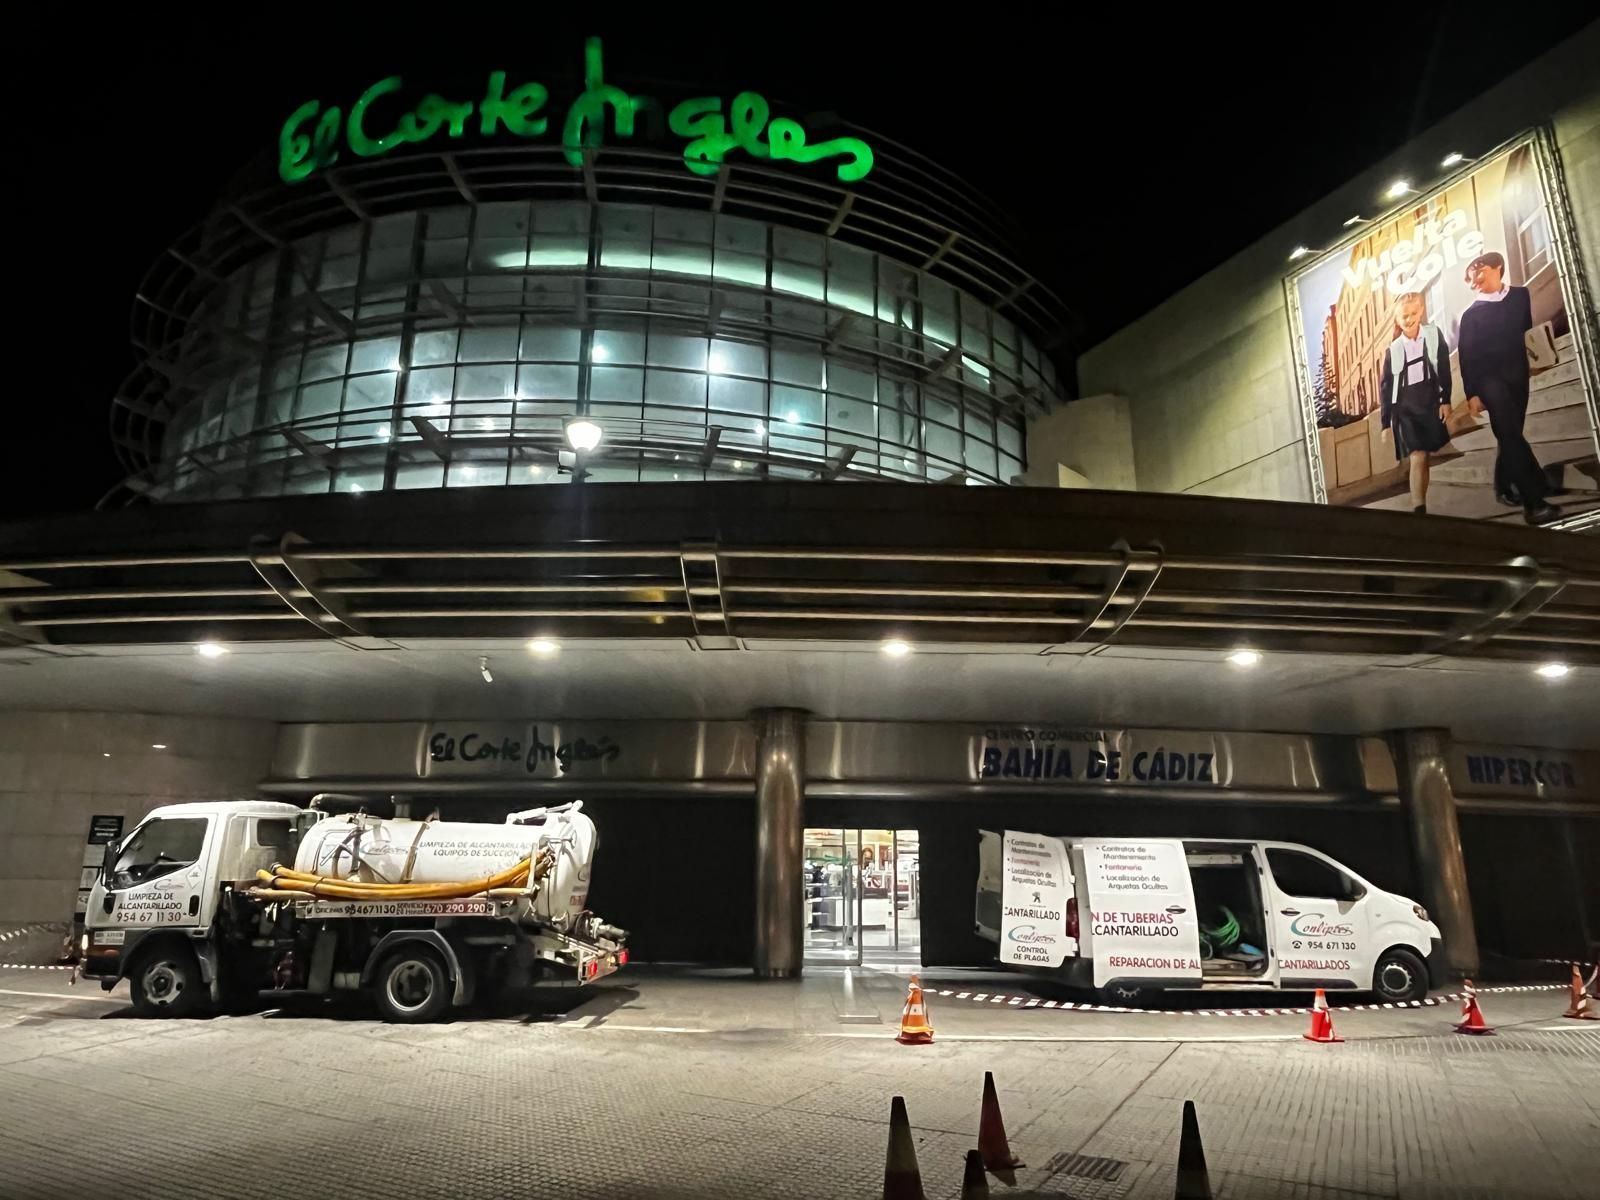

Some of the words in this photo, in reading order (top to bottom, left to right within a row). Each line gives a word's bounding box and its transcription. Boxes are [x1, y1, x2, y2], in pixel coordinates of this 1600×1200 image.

[279, 99, 341, 182] El
[347, 70, 549, 157] Corte
[1341, 209, 1467, 288] Vuelta
[1386, 230, 1485, 295] Cole
[430, 733, 455, 762] El
[460, 733, 521, 762] Corte
[984, 744, 1072, 778] BAHÍA
[1087, 751, 1121, 780] DE
[1132, 747, 1214, 782] CÁDIZ
[419, 841, 456, 849] LIMPIEZA
[1101, 845, 1135, 853] Contratos
[433, 849, 469, 857] EQUIPOS
[470, 849, 481, 857] DE
[1108, 882, 1140, 891] Arquetas
[1141, 882, 1168, 890] Ocultas
[128, 892, 162, 901] LIMPIEZA
[163, 892, 174, 901] DE
[118, 902, 182, 910] ALCANTARILLADO
[424, 903, 444, 914] 670
[445, 903, 465, 914] 290
[467, 903, 486, 914] 290
[117, 912, 136, 923] 954
[140, 912, 153, 922] 67
[156, 911, 164, 922] 11
[168, 912, 182, 922] 30
[1103, 912, 1118, 922] DE
[1120, 912, 1174, 924] TUBERIAS
[1016, 945, 1048, 955] CONTROL
[1307, 941, 1324, 949] 954
[1326, 942, 1340, 950] 671
[1341, 942, 1356, 950] 130
[1024, 954, 1050, 962] PLAGAS
[1109, 956, 1171, 969] REPARACION
[1173, 959, 1187, 969] DE
[1188, 960, 1201, 970] AL
[1278, 959, 1351, 970] CANTARILLADOS
